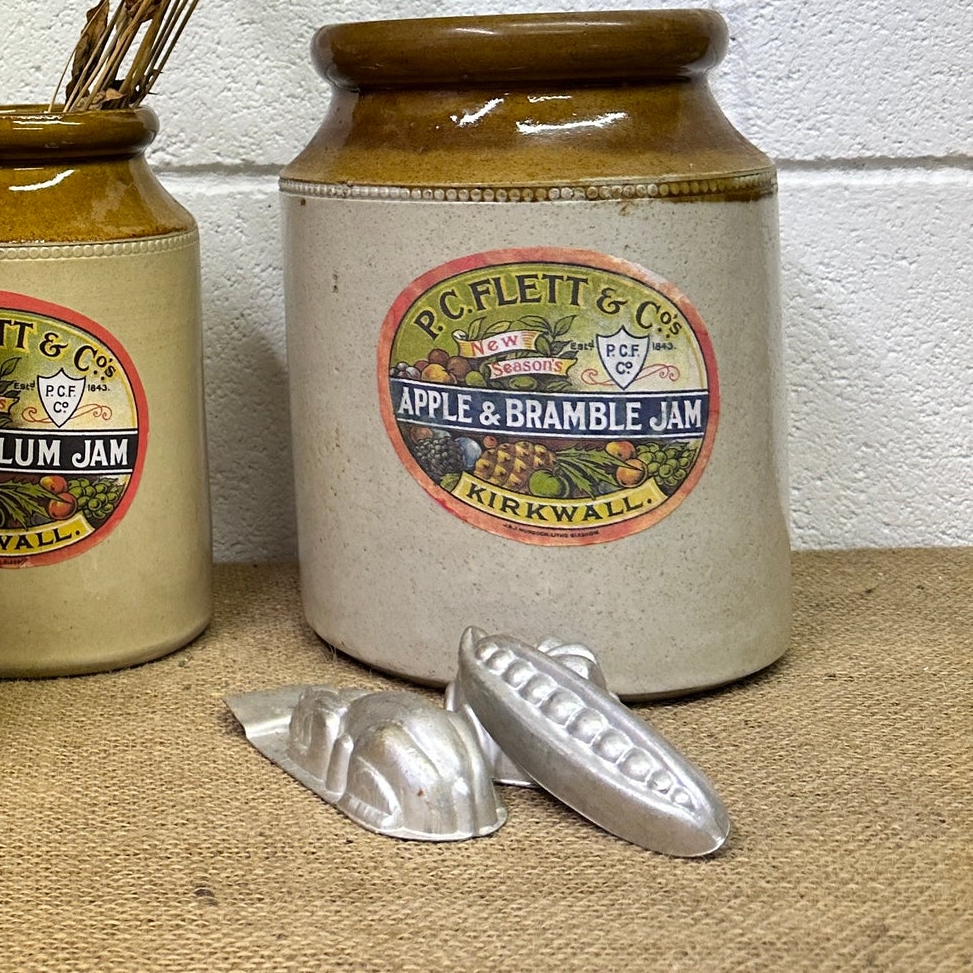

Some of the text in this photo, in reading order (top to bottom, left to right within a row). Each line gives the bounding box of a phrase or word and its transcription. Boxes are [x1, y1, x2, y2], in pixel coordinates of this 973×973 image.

[596, 288, 628, 315] &
[39, 332, 68, 357] &
[471, 333, 518, 357] New
[491, 359, 563, 377] Season's
[398, 386, 702, 433] APPLE & BRAMBLE JAM
[72, 438, 129, 469] JAM
